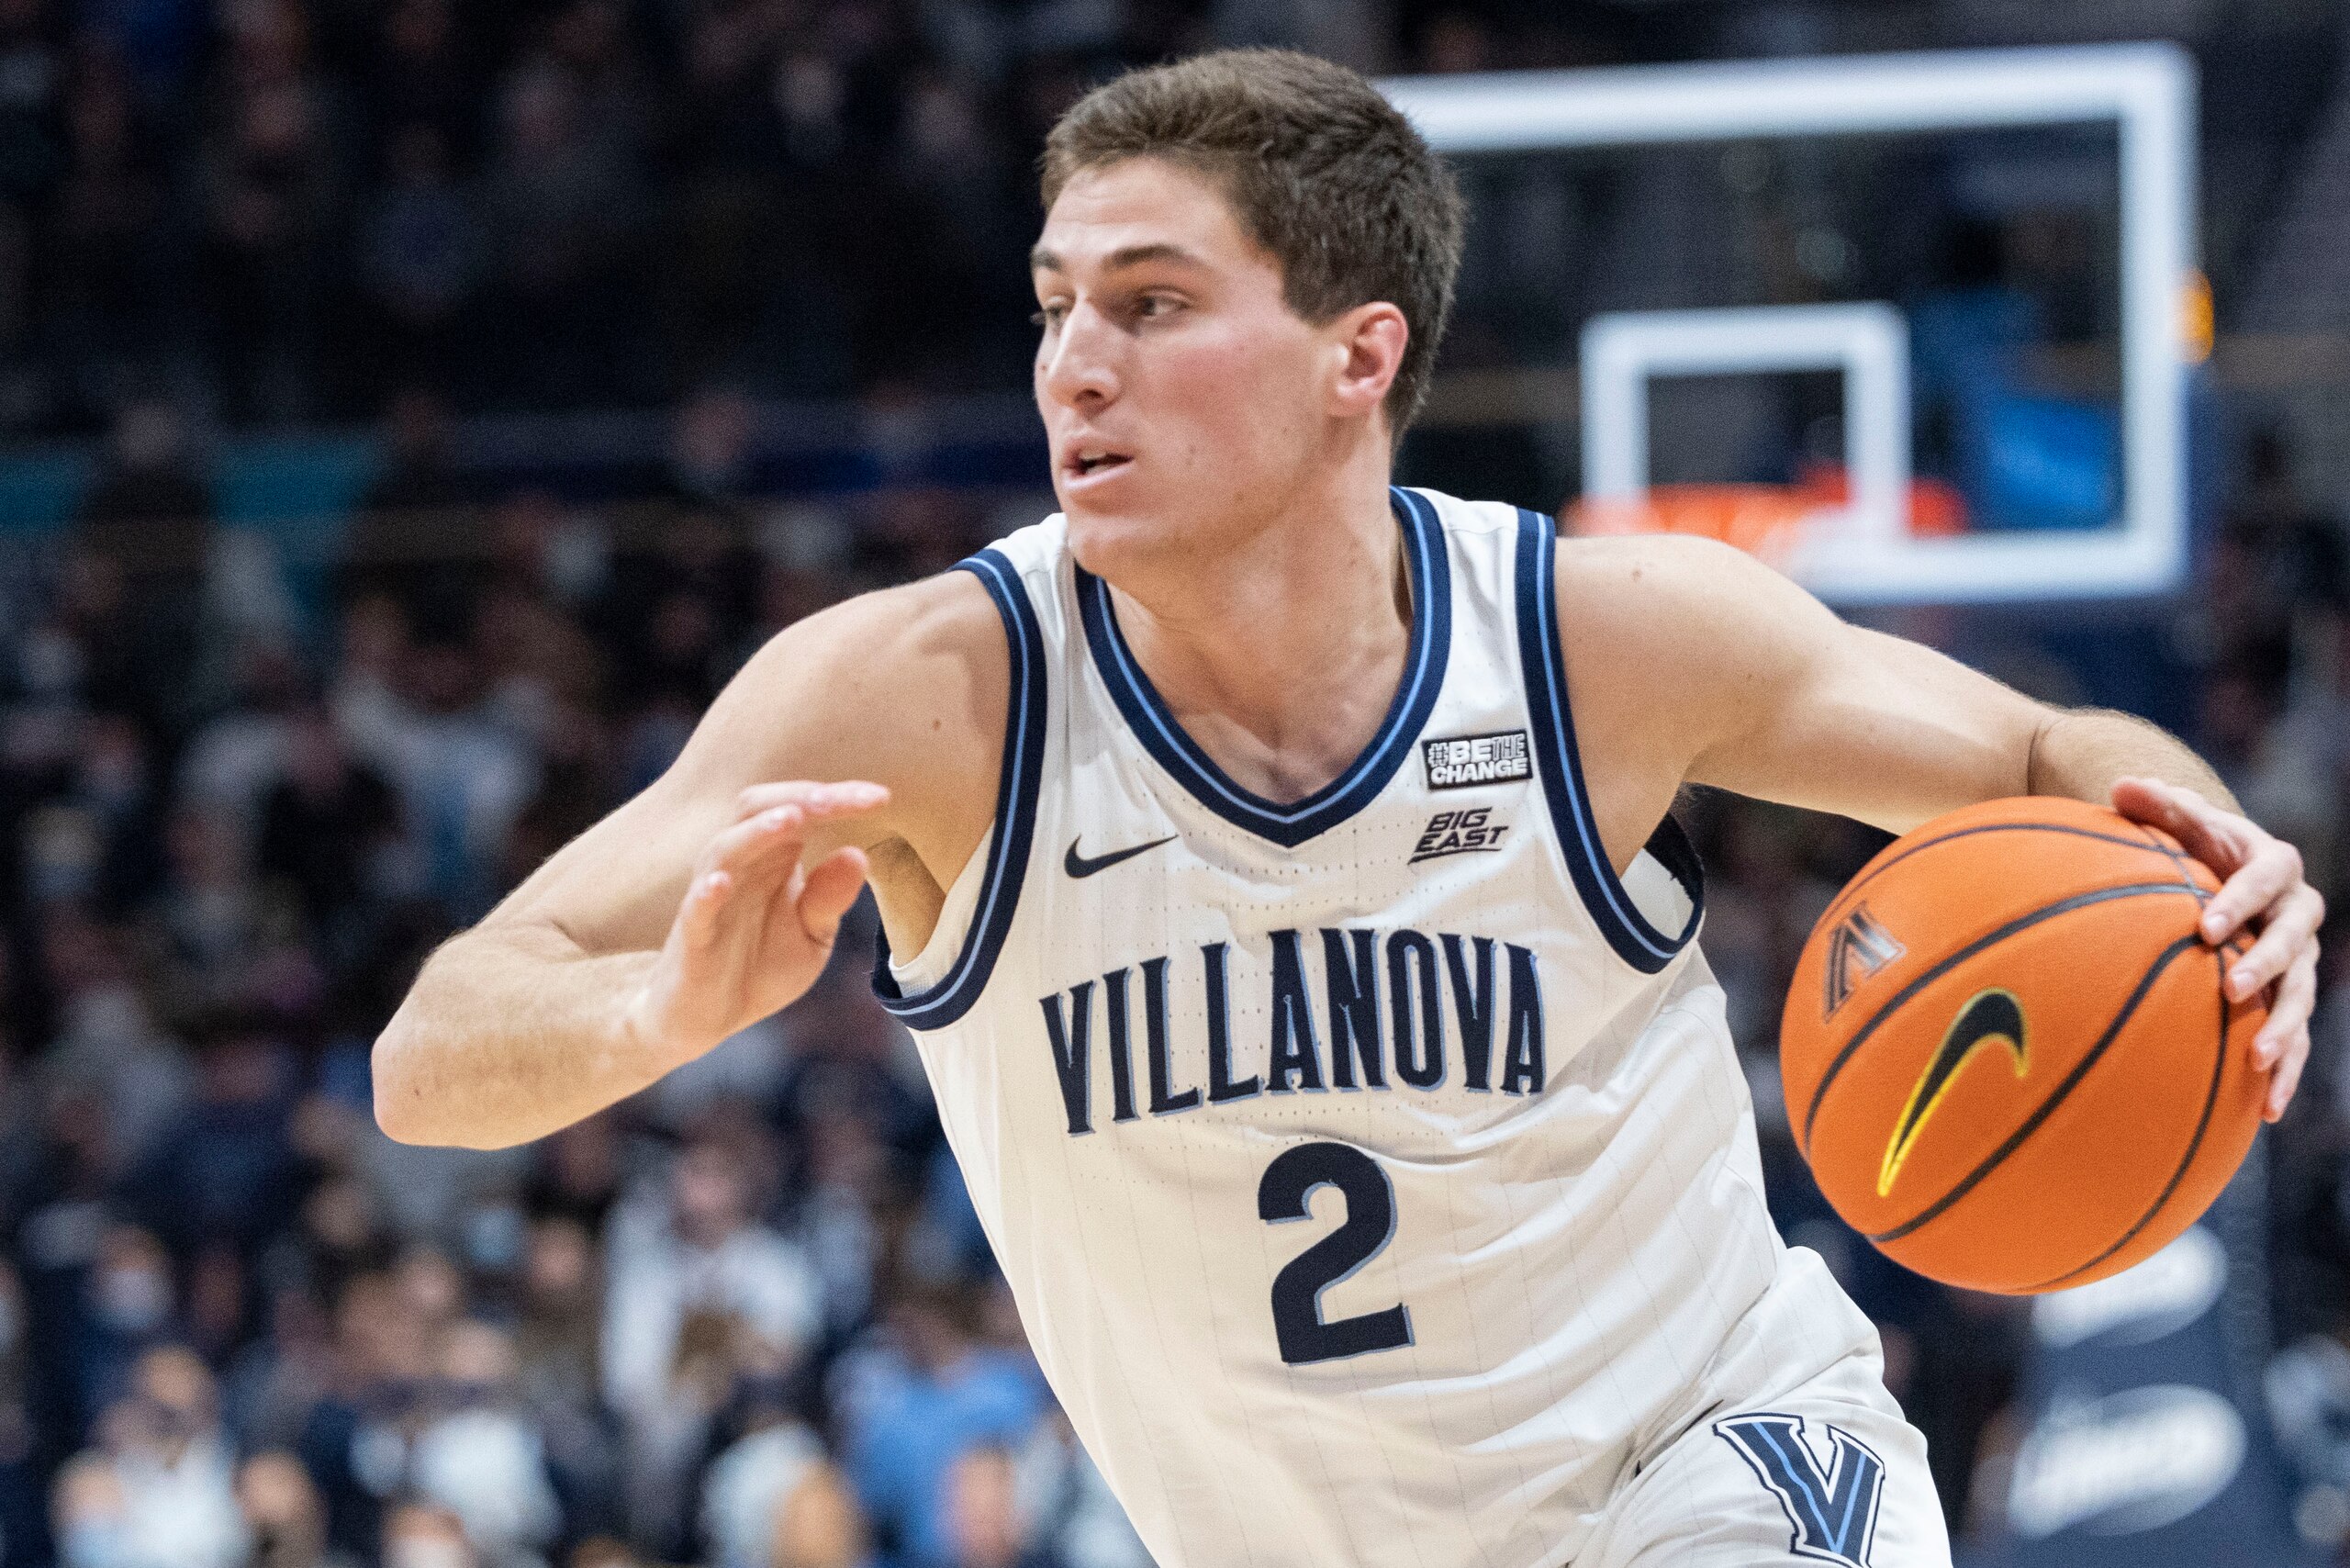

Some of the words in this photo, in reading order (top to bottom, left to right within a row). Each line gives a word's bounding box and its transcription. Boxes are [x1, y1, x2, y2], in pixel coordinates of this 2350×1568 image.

[1430, 756, 1528, 785] CHANGE
[1415, 825, 1509, 853] EAST
[1425, 806, 1493, 833] BIG
[1038, 927, 1546, 1137] VILLANOVA
[1258, 1142, 1416, 1367] 2
[1711, 1412, 1886, 1568] V
